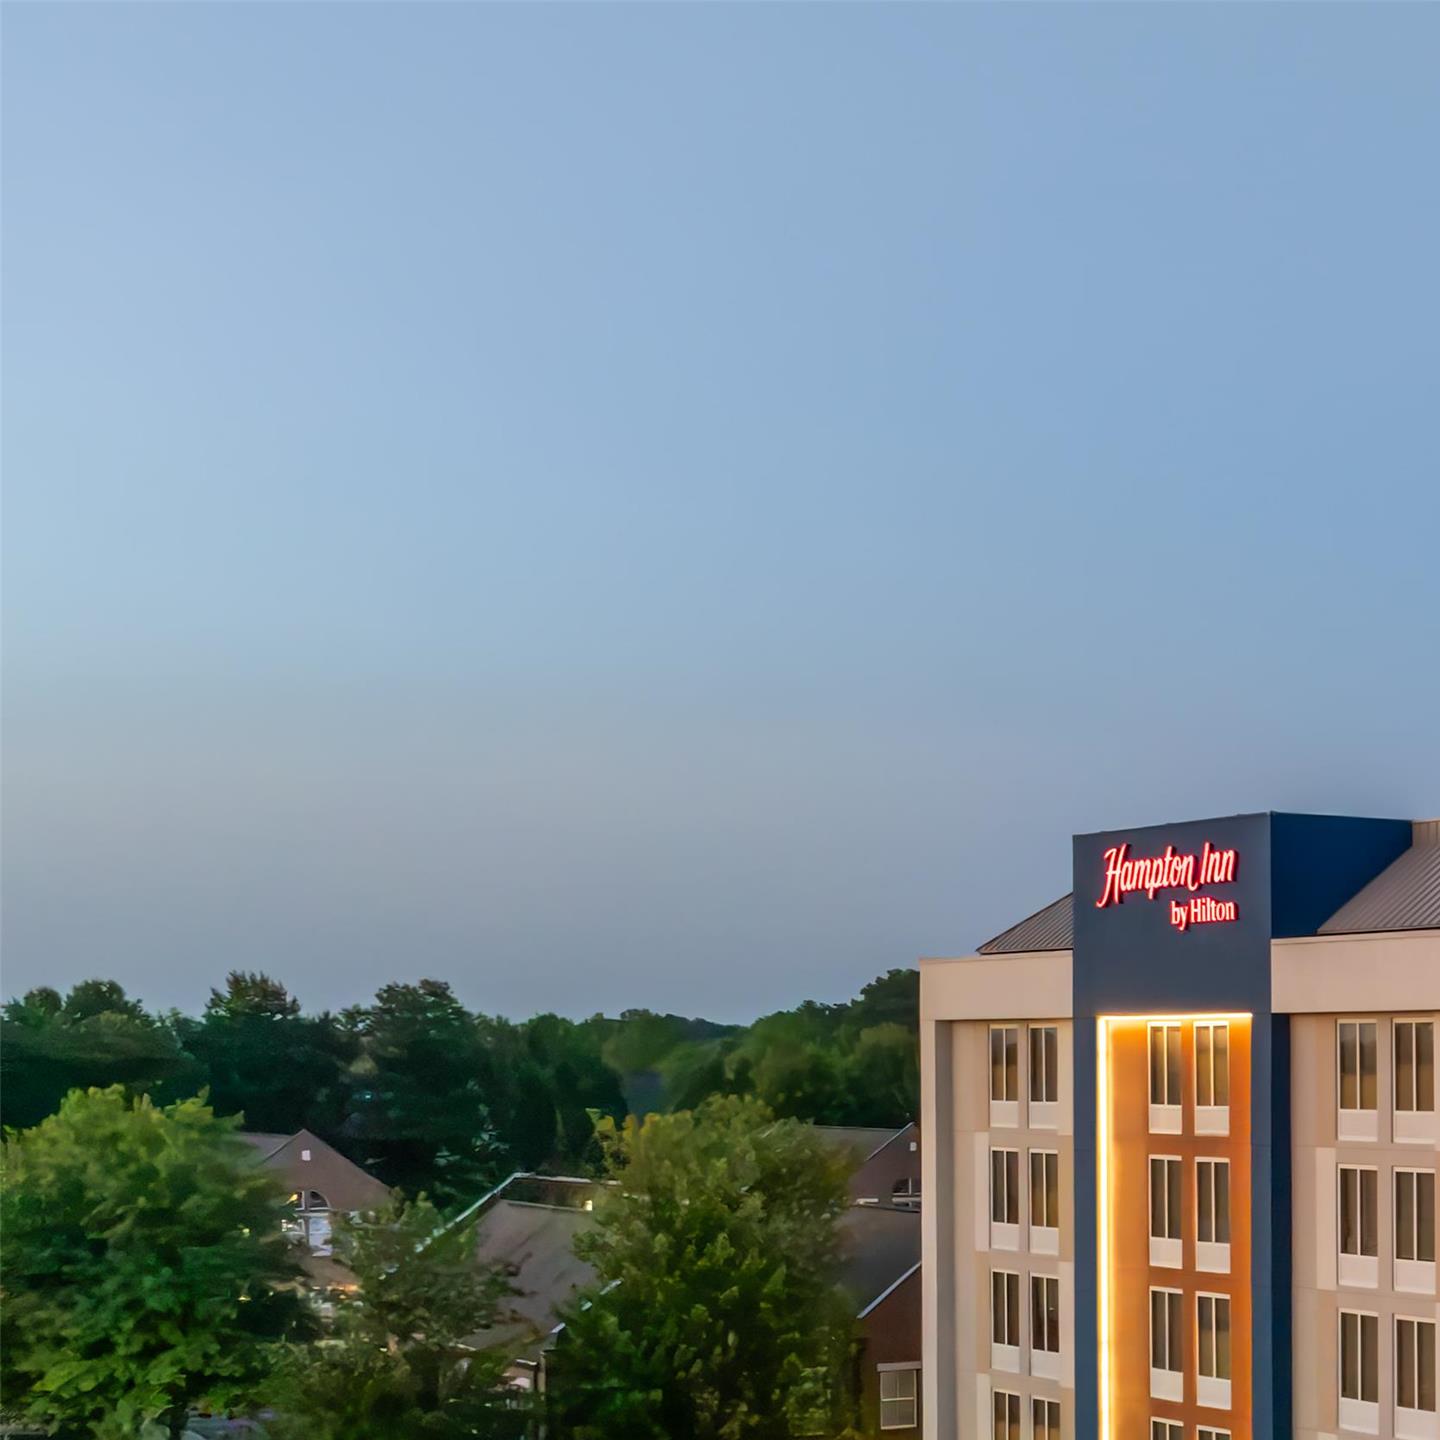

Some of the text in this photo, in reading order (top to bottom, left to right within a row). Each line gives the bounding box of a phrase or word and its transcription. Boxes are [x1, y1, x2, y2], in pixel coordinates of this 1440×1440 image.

[1096, 841, 1236, 908] Hampton Inn
[1171, 897, 1236, 931] by Hilton
